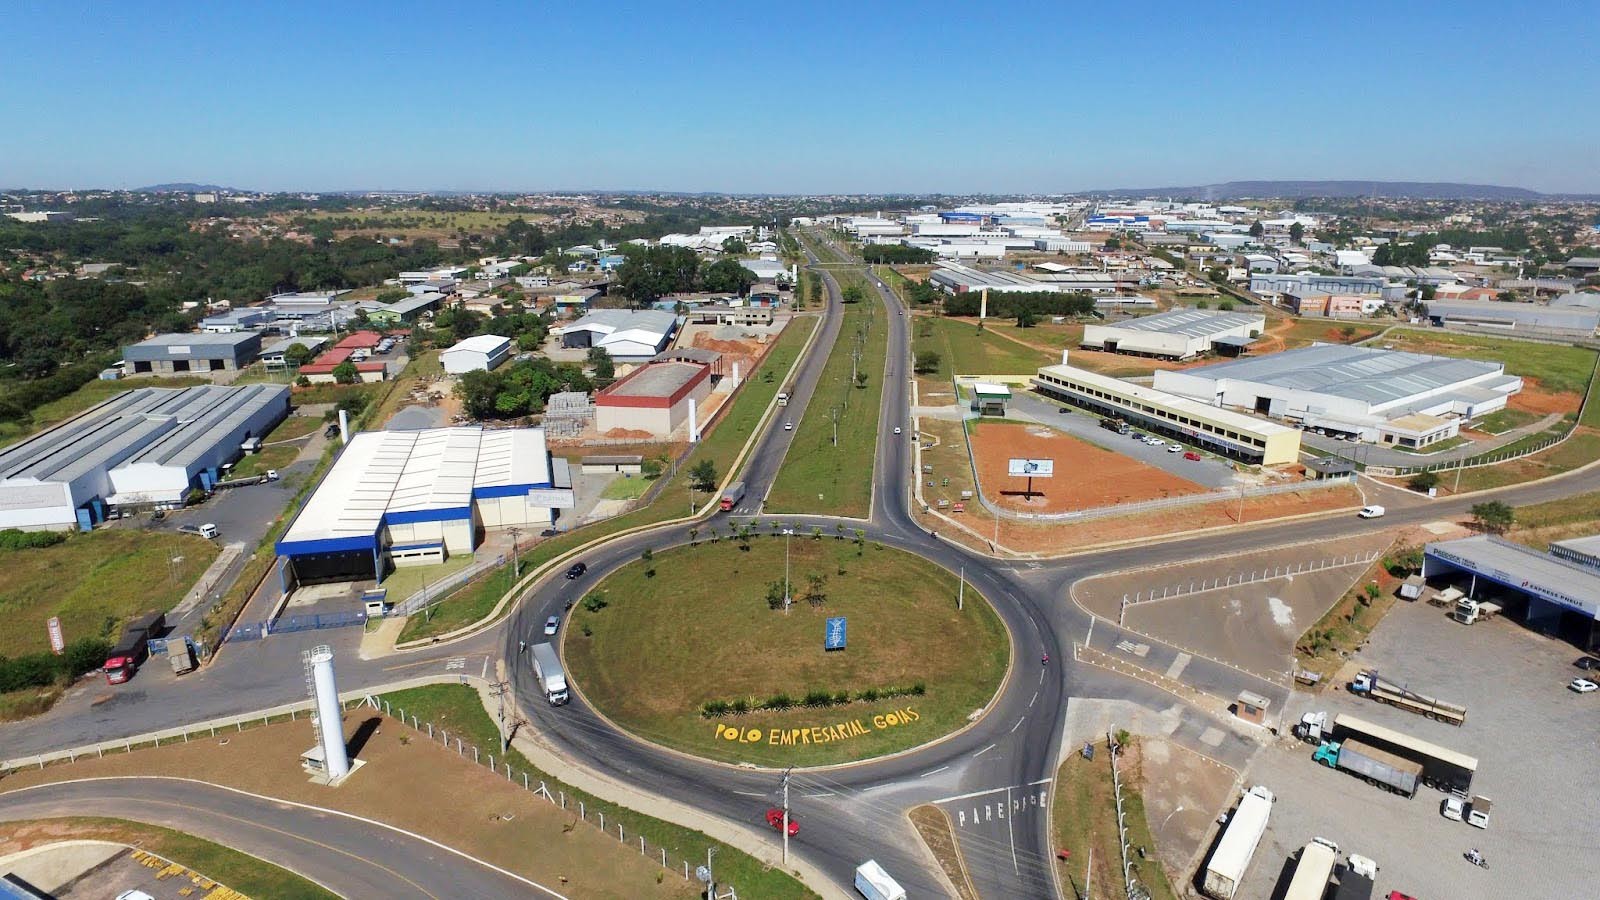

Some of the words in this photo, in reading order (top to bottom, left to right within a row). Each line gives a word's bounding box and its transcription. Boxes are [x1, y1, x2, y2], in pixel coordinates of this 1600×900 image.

[1529, 584, 1559, 598] EXPRESS
[1560, 595, 1583, 607] PNEUS
[714, 723, 762, 744] POLO
[769, 719, 871, 746] EMPRESARIAL
[873, 706, 920, 729] GOIAS
[959, 802, 1005, 827] PARE
